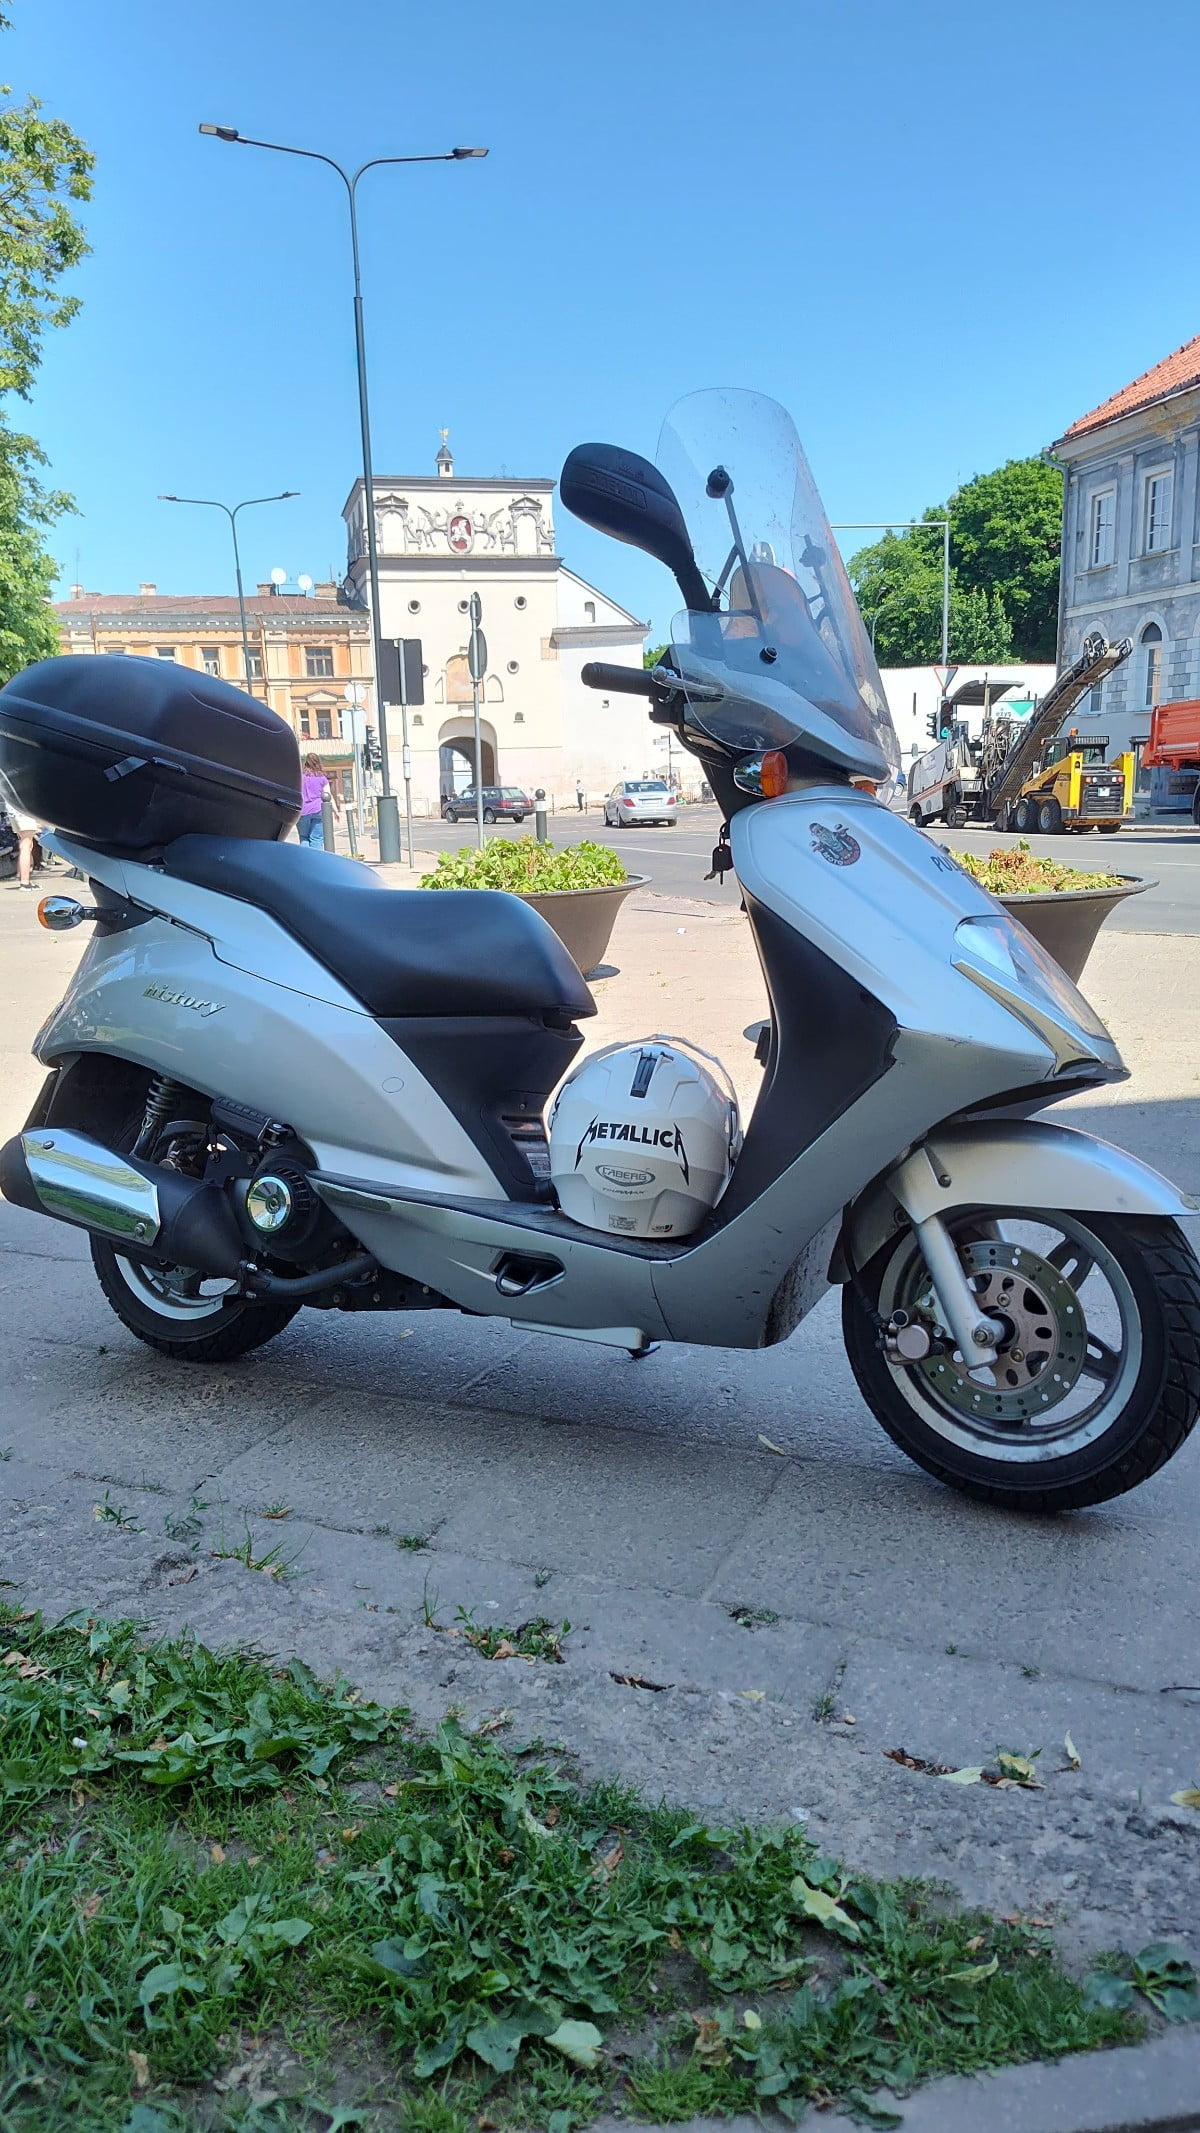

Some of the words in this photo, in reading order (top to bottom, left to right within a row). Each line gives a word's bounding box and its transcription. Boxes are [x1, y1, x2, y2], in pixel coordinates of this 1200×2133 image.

[142, 981, 226, 1018] history
[574, 1113, 690, 1186] METALLICA
[602, 1167, 647, 1181] CABERG
